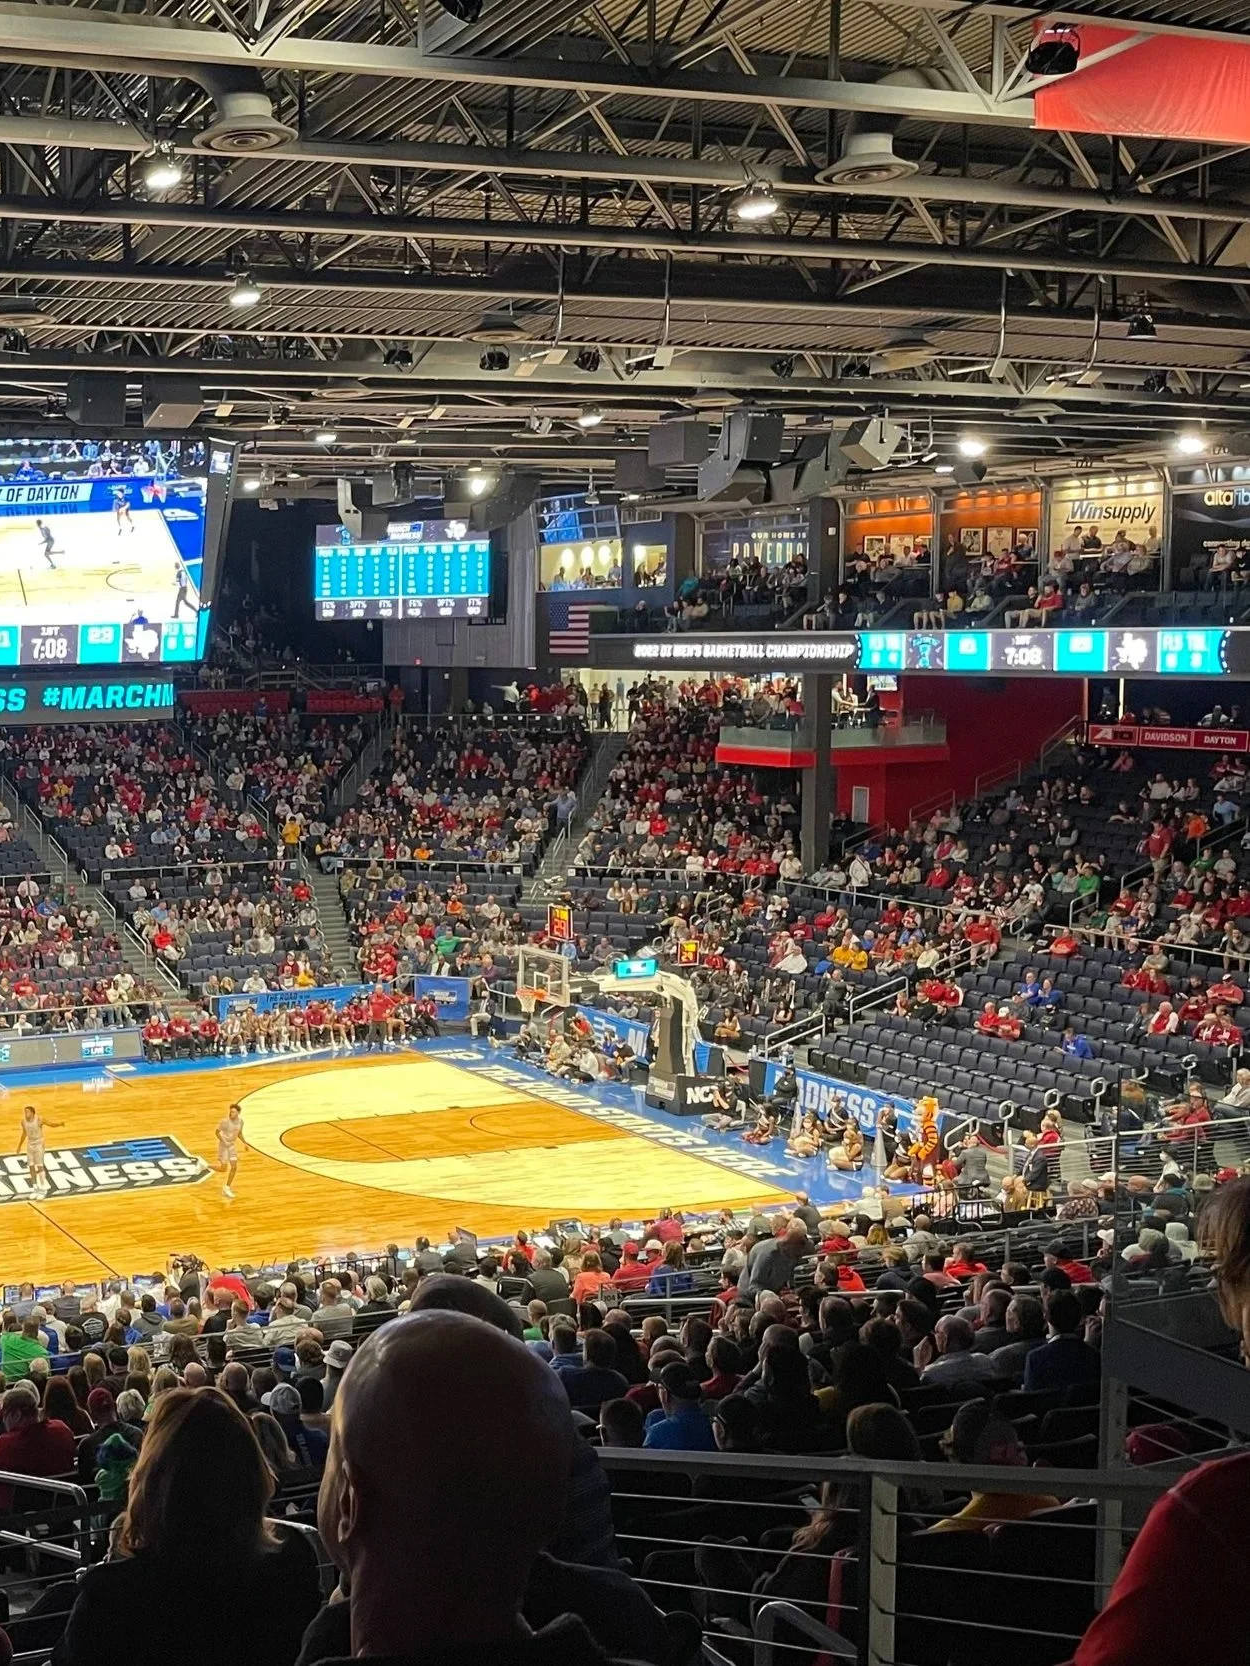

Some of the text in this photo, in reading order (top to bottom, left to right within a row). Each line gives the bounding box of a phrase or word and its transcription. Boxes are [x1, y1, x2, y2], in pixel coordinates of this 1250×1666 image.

[6, 487, 23, 502] OF
[28, 485, 80, 502] DAYTON
[1068, 500, 1157, 524] Winsupply
[732, 542, 810, 563] POWERHO
[40, 626, 61, 636] 1ST
[31, 637, 68, 660] 7:08
[702, 644, 766, 659] BASKETBALL
[766, 644, 854, 659] CHAMPIONSHIP
[1004, 647, 1042, 665] 7:08
[1144, 731, 1188, 743] DAVIDSON
[1203, 735, 1237, 745] DAYTON
[467, 1064, 799, 1179] THE ROAD STARTS HERE
